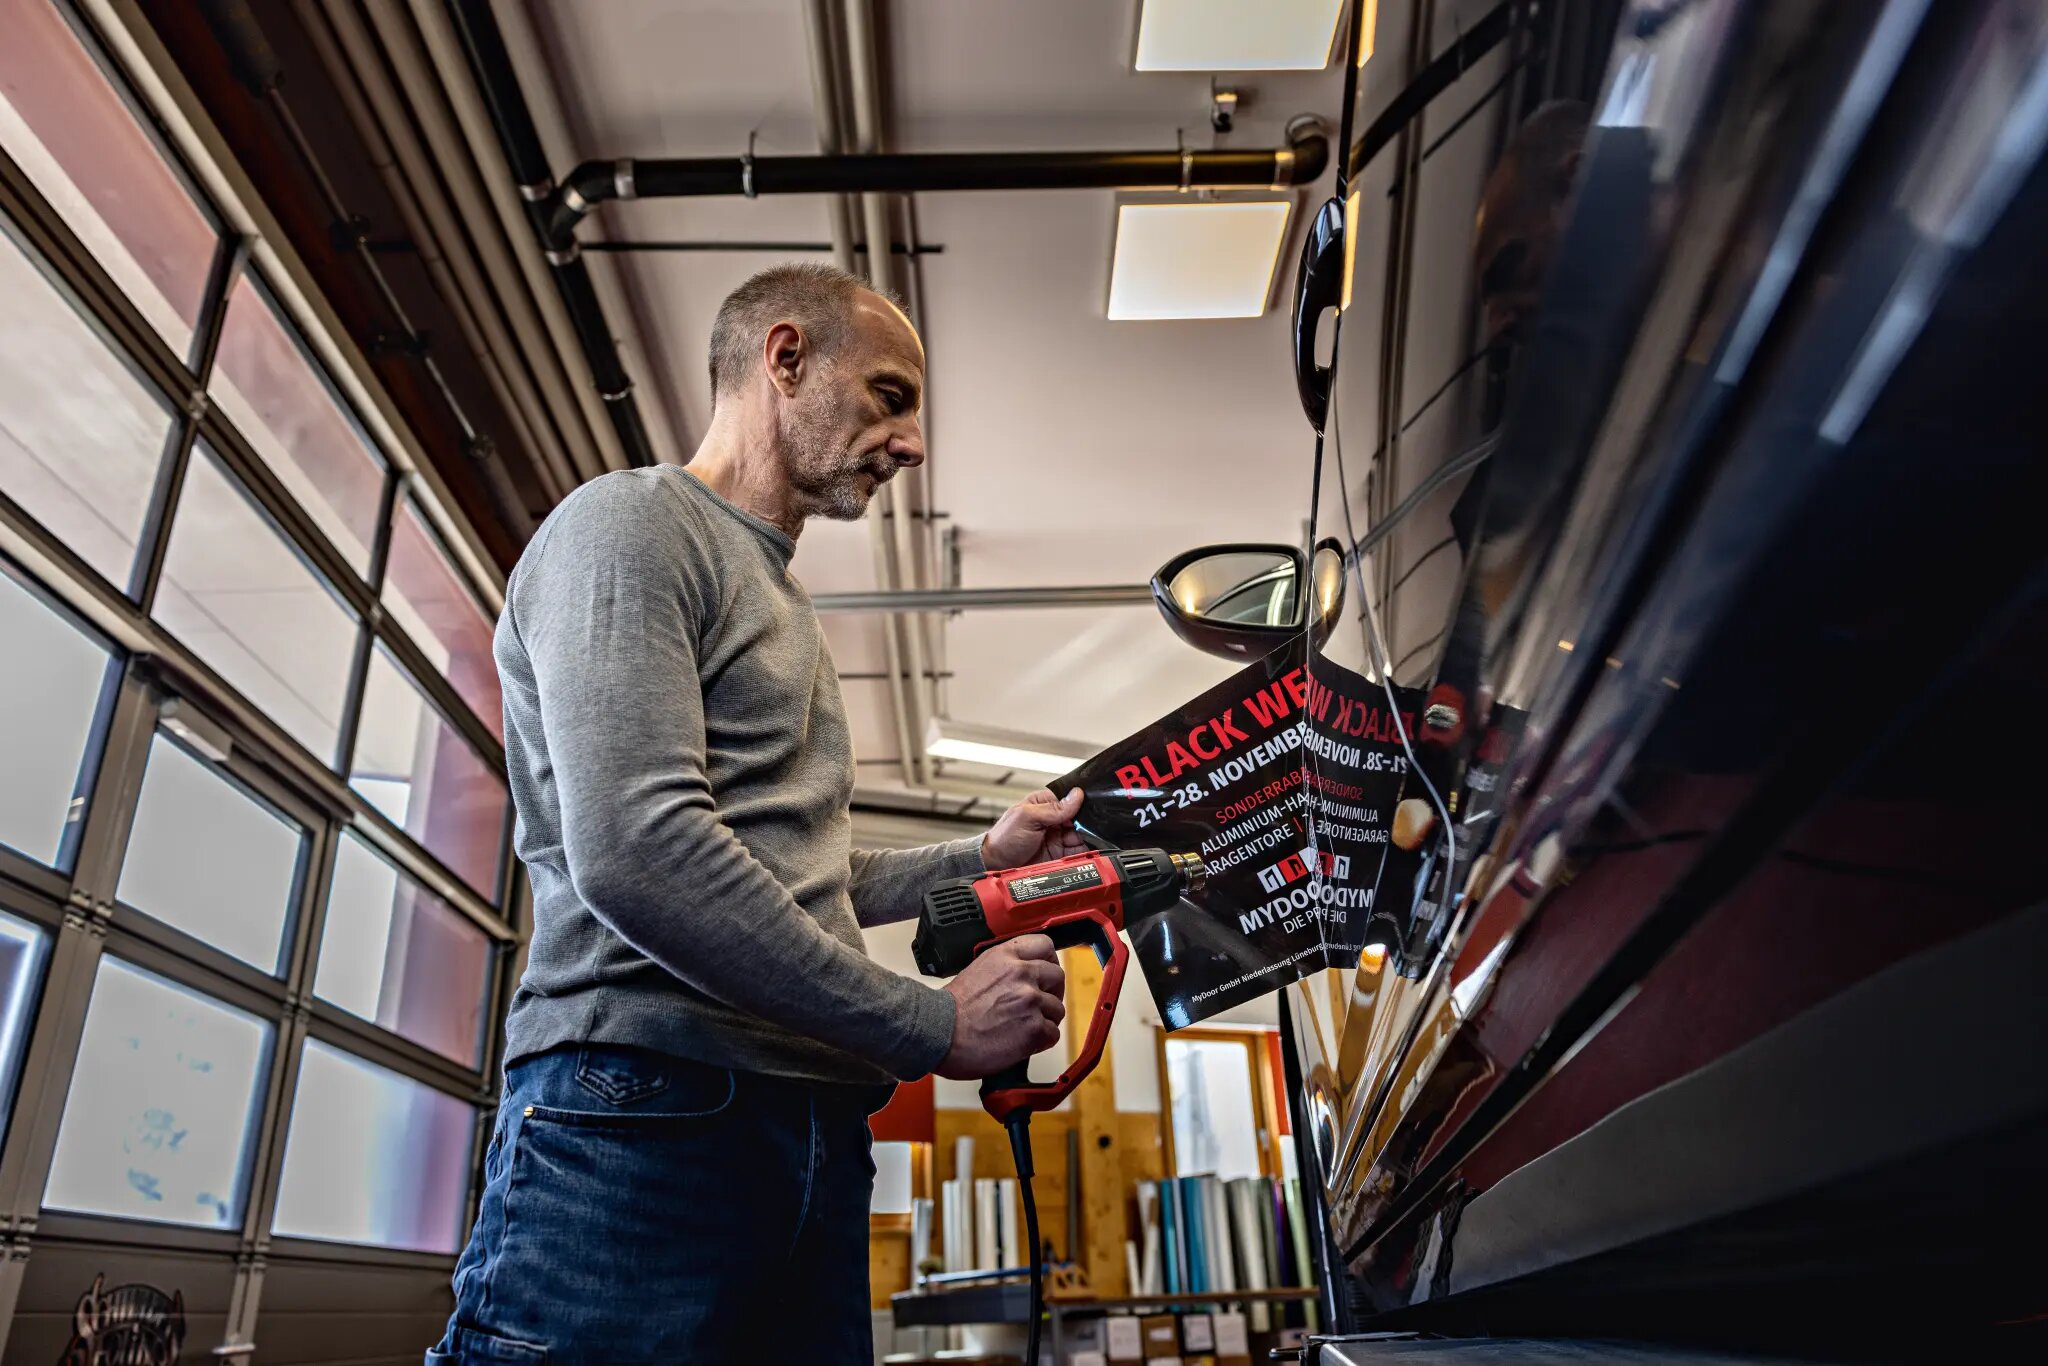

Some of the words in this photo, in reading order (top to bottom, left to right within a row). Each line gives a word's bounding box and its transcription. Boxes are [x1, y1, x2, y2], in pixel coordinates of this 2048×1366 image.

[1115, 708, 1250, 799] BLACK
[1242, 663, 1308, 729] WE
[1076, 863, 1095, 872] FLEX
[1204, 823, 1295, 879] ARAGENTORE
[1283, 914, 1307, 934] DIE
[1191, 986, 1219, 1003] MyDoor
[1219, 977, 1242, 992] GmbH
[1241, 956, 1293, 983] Niederlassung
